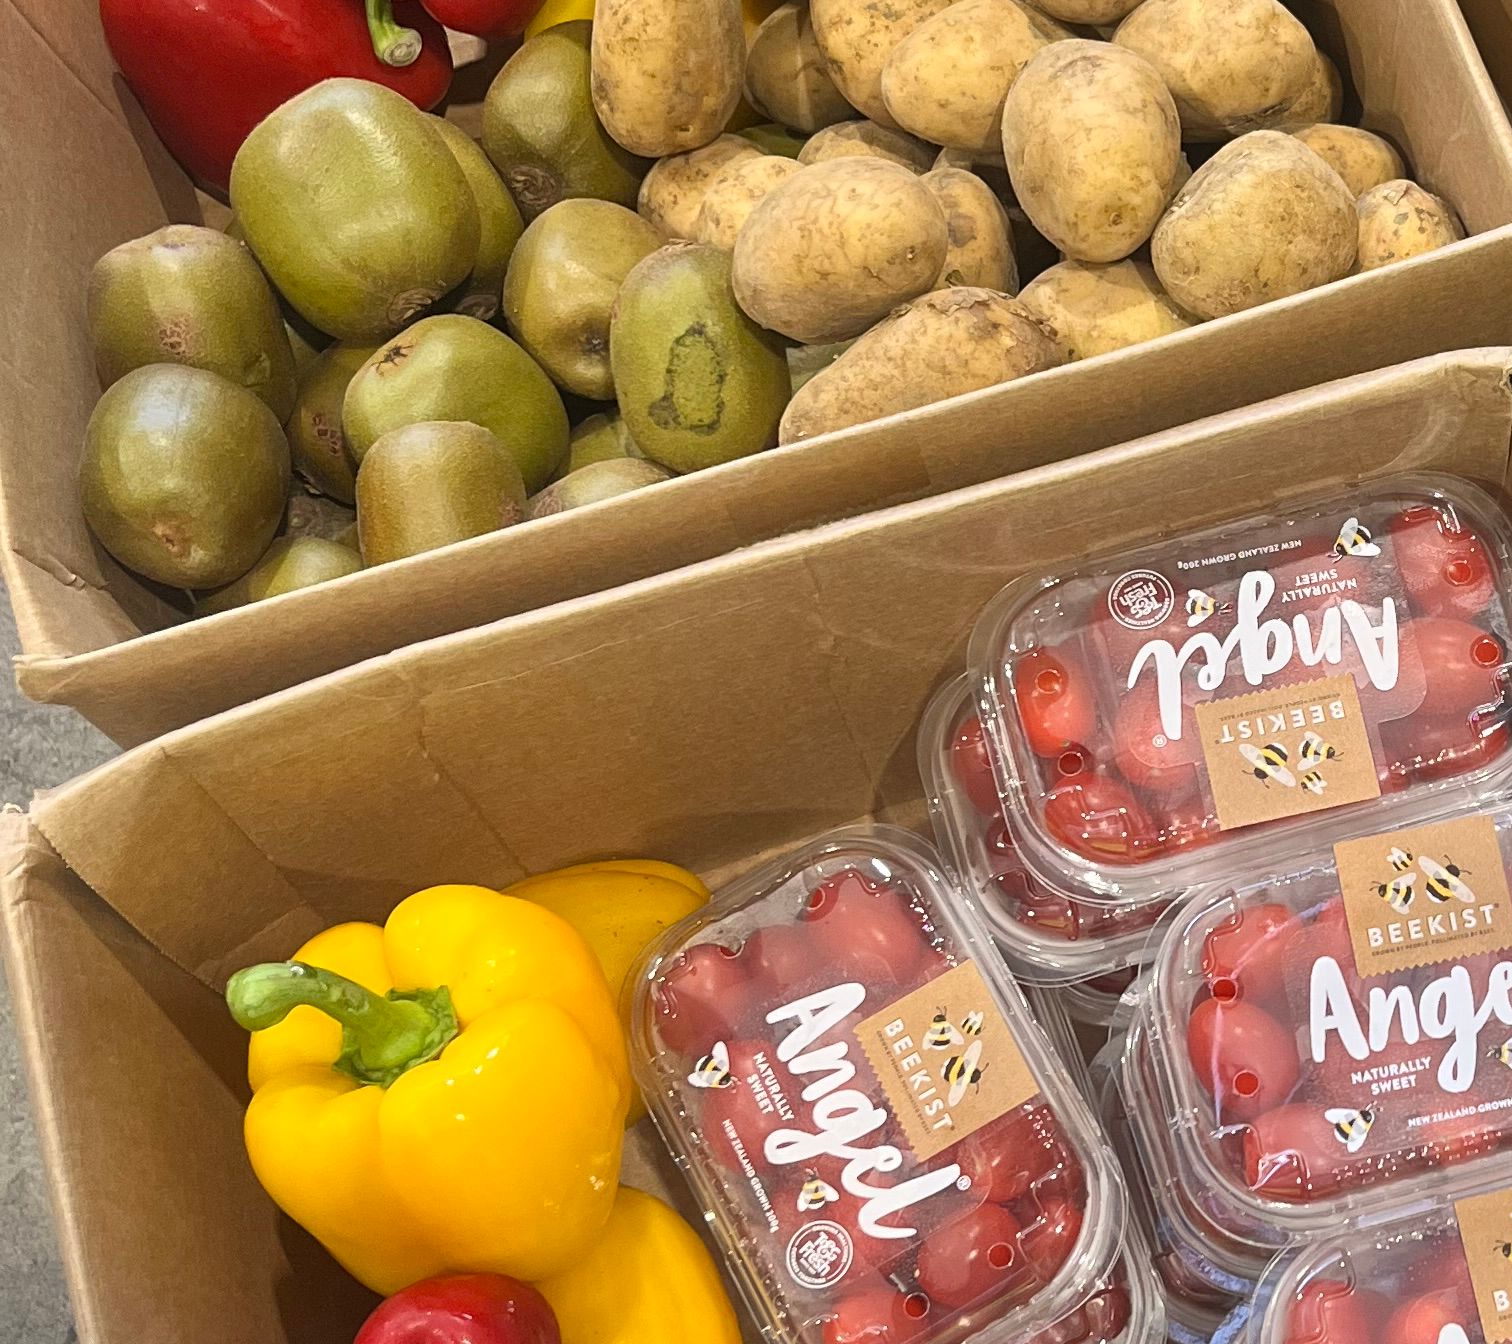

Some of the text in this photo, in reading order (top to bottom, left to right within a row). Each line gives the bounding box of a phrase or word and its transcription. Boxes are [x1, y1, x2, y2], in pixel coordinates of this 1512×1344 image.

[1176, 540, 1302, 570] NEW ZEALAND GROWN 200g
[1118, 582, 1157, 606] Fresh
[1280, 577, 1356, 602] NATURALLY
[1294, 567, 1337, 586] SWEET
[1127, 570, 1398, 740] Angel
[1218, 700, 1344, 744] BEEKIST
[1367, 903, 1496, 947] BEEKIST
[752, 1052, 793, 1122] NATURALLY
[884, 1018, 953, 1133] BEEKIST
[1351, 1056, 1431, 1084] NATURALLY
[1370, 1074, 1416, 1095] SWEET
[745, 1073, 773, 1115] SWEET
[764, 982, 960, 1238] Angel
[1408, 1115, 1430, 1127] NEW
[1431, 1106, 1477, 1122] ZEALAND
[723, 1118, 738, 1138] NEW
[732, 1137, 756, 1179] ZEALAND
[750, 1176, 771, 1211] GROWN
[798, 1240, 830, 1277] Fresh
